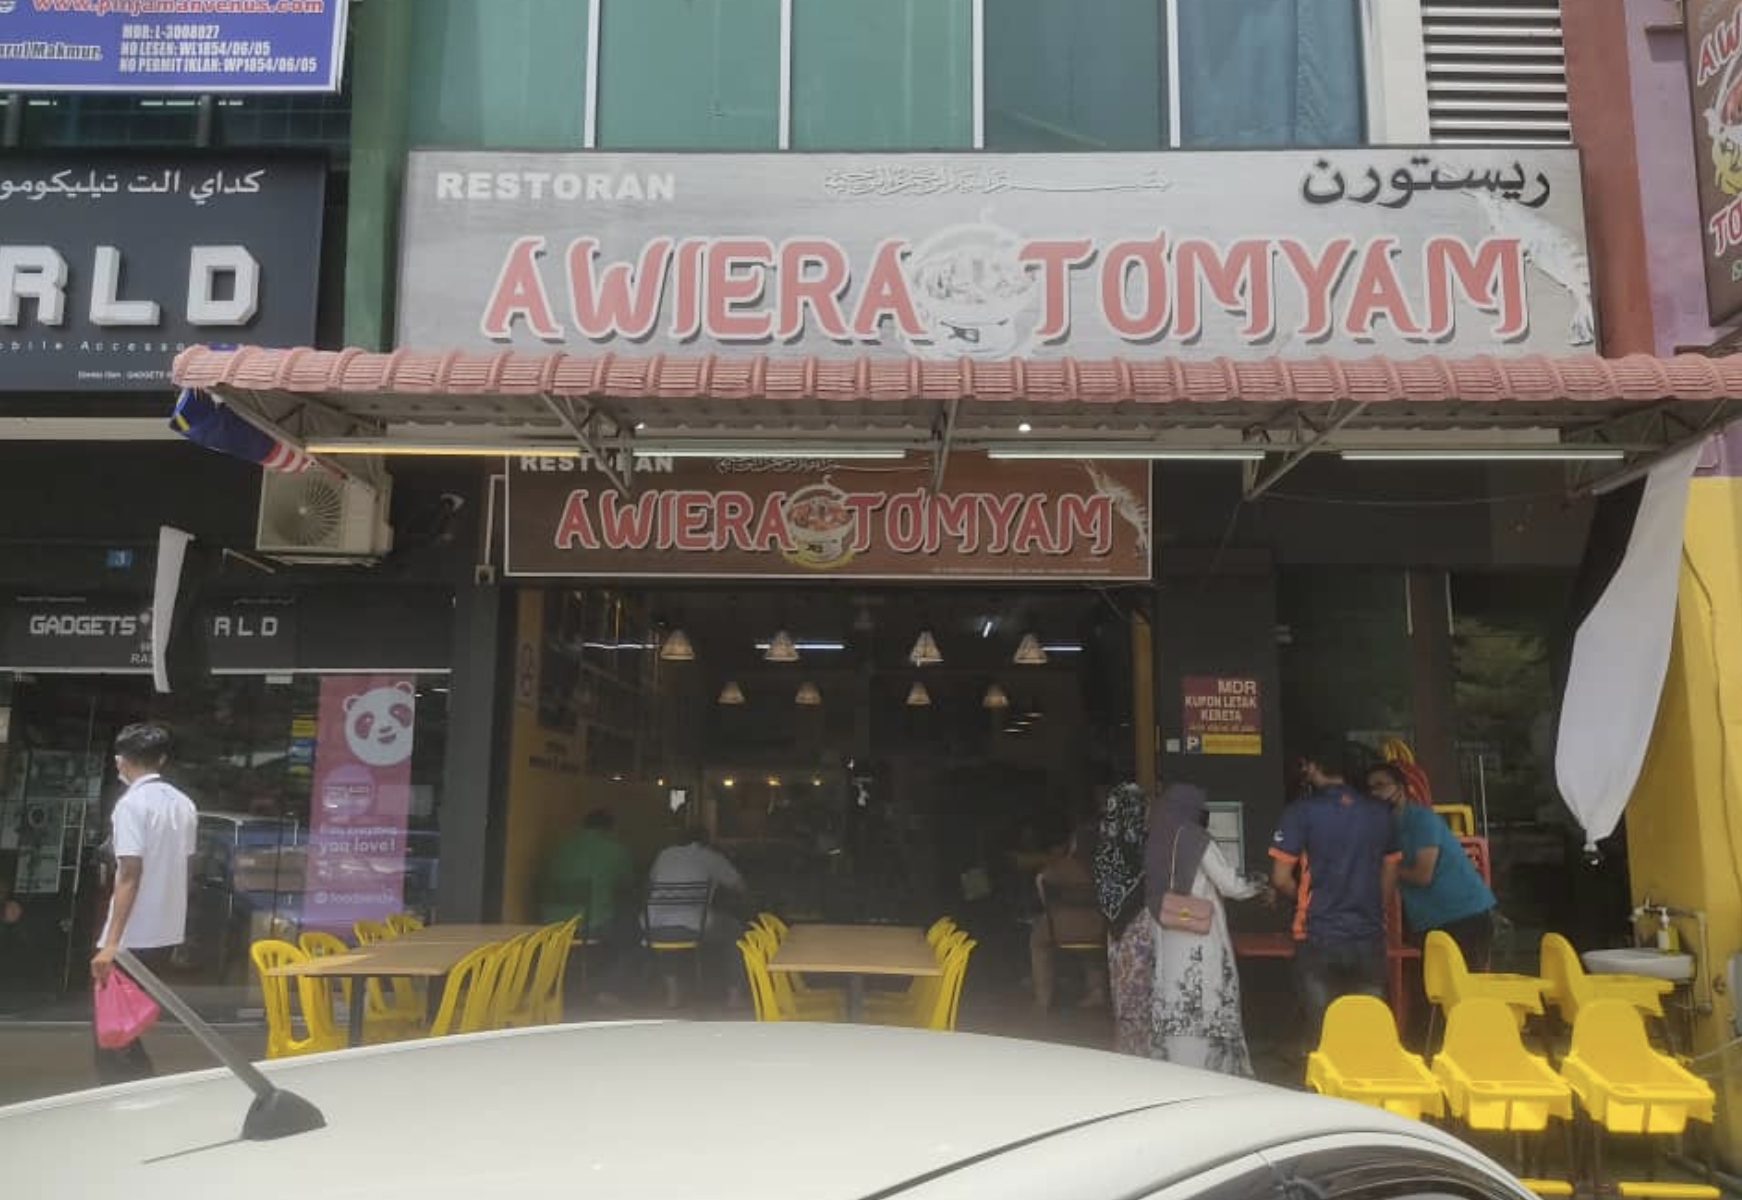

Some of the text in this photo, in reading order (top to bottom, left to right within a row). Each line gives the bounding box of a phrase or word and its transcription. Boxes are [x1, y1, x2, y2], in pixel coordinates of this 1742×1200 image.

[120, 41, 138, 57] NO
[139, 41, 179, 57] LESEN:
[119, 57, 137, 73] NO
[138, 57, 183, 73] PERMIT
[183, 57, 222, 73] IKLAN:
[436, 171, 676, 201] RESTORAN
[480, 231, 1533, 344] AWIERA TOMYAM
[554, 487, 1115, 555] AWIERA TOMYAM
[29, 615, 137, 636] GADGETS
[1218, 680, 1257, 694] MDR
[1185, 696, 1257, 708] KUPON LETAK
